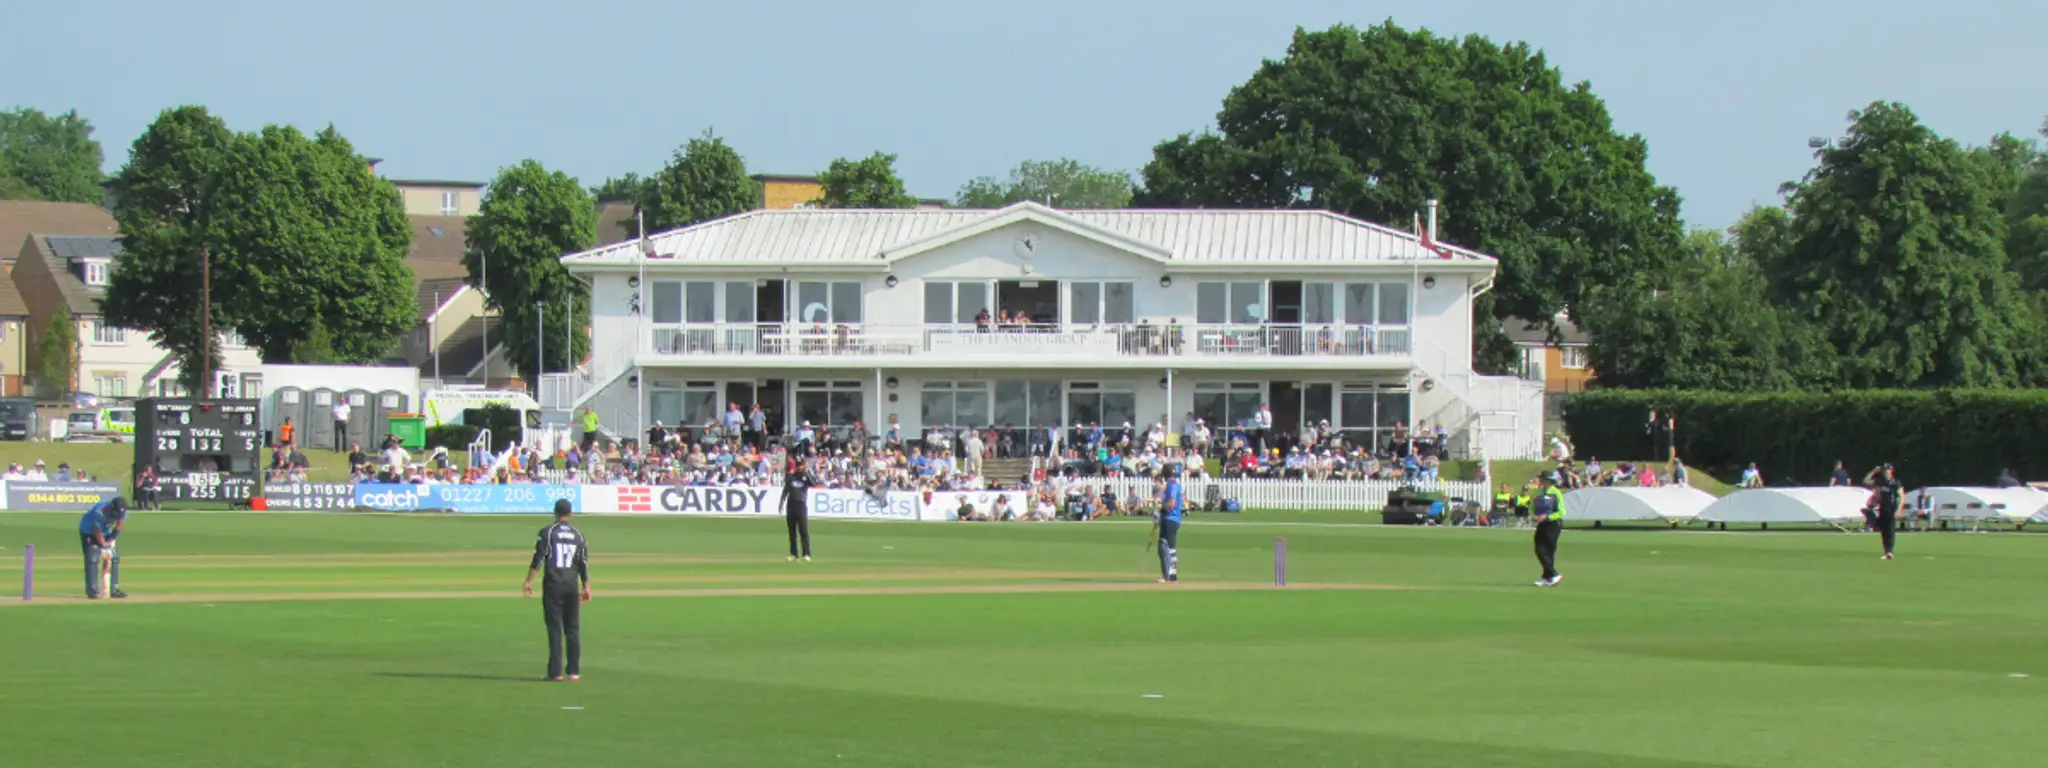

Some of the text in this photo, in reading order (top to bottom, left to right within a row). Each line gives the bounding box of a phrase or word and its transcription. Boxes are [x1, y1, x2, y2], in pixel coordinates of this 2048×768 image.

[1046, 333, 1087, 346] GROUP
[244, 412, 254, 426] 9
[190, 428, 223, 437] TOTAL
[245, 438, 254, 451] 5
[176, 485, 181, 498] 1
[191, 486, 216, 498] 255
[293, 483, 301, 495] 8
[303, 484, 312, 495] 9
[346, 484, 354, 495] 7
[293, 497, 301, 508] 4
[303, 497, 312, 508] 5
[314, 497, 322, 508] 3
[325, 498, 334, 508] 7
[336, 498, 345, 508] 4
[346, 498, 355, 508] 4
[361, 487, 577, 508] catch 01227 206 989
[660, 487, 768, 513] CARDY
[556, 543, 577, 568] 17
